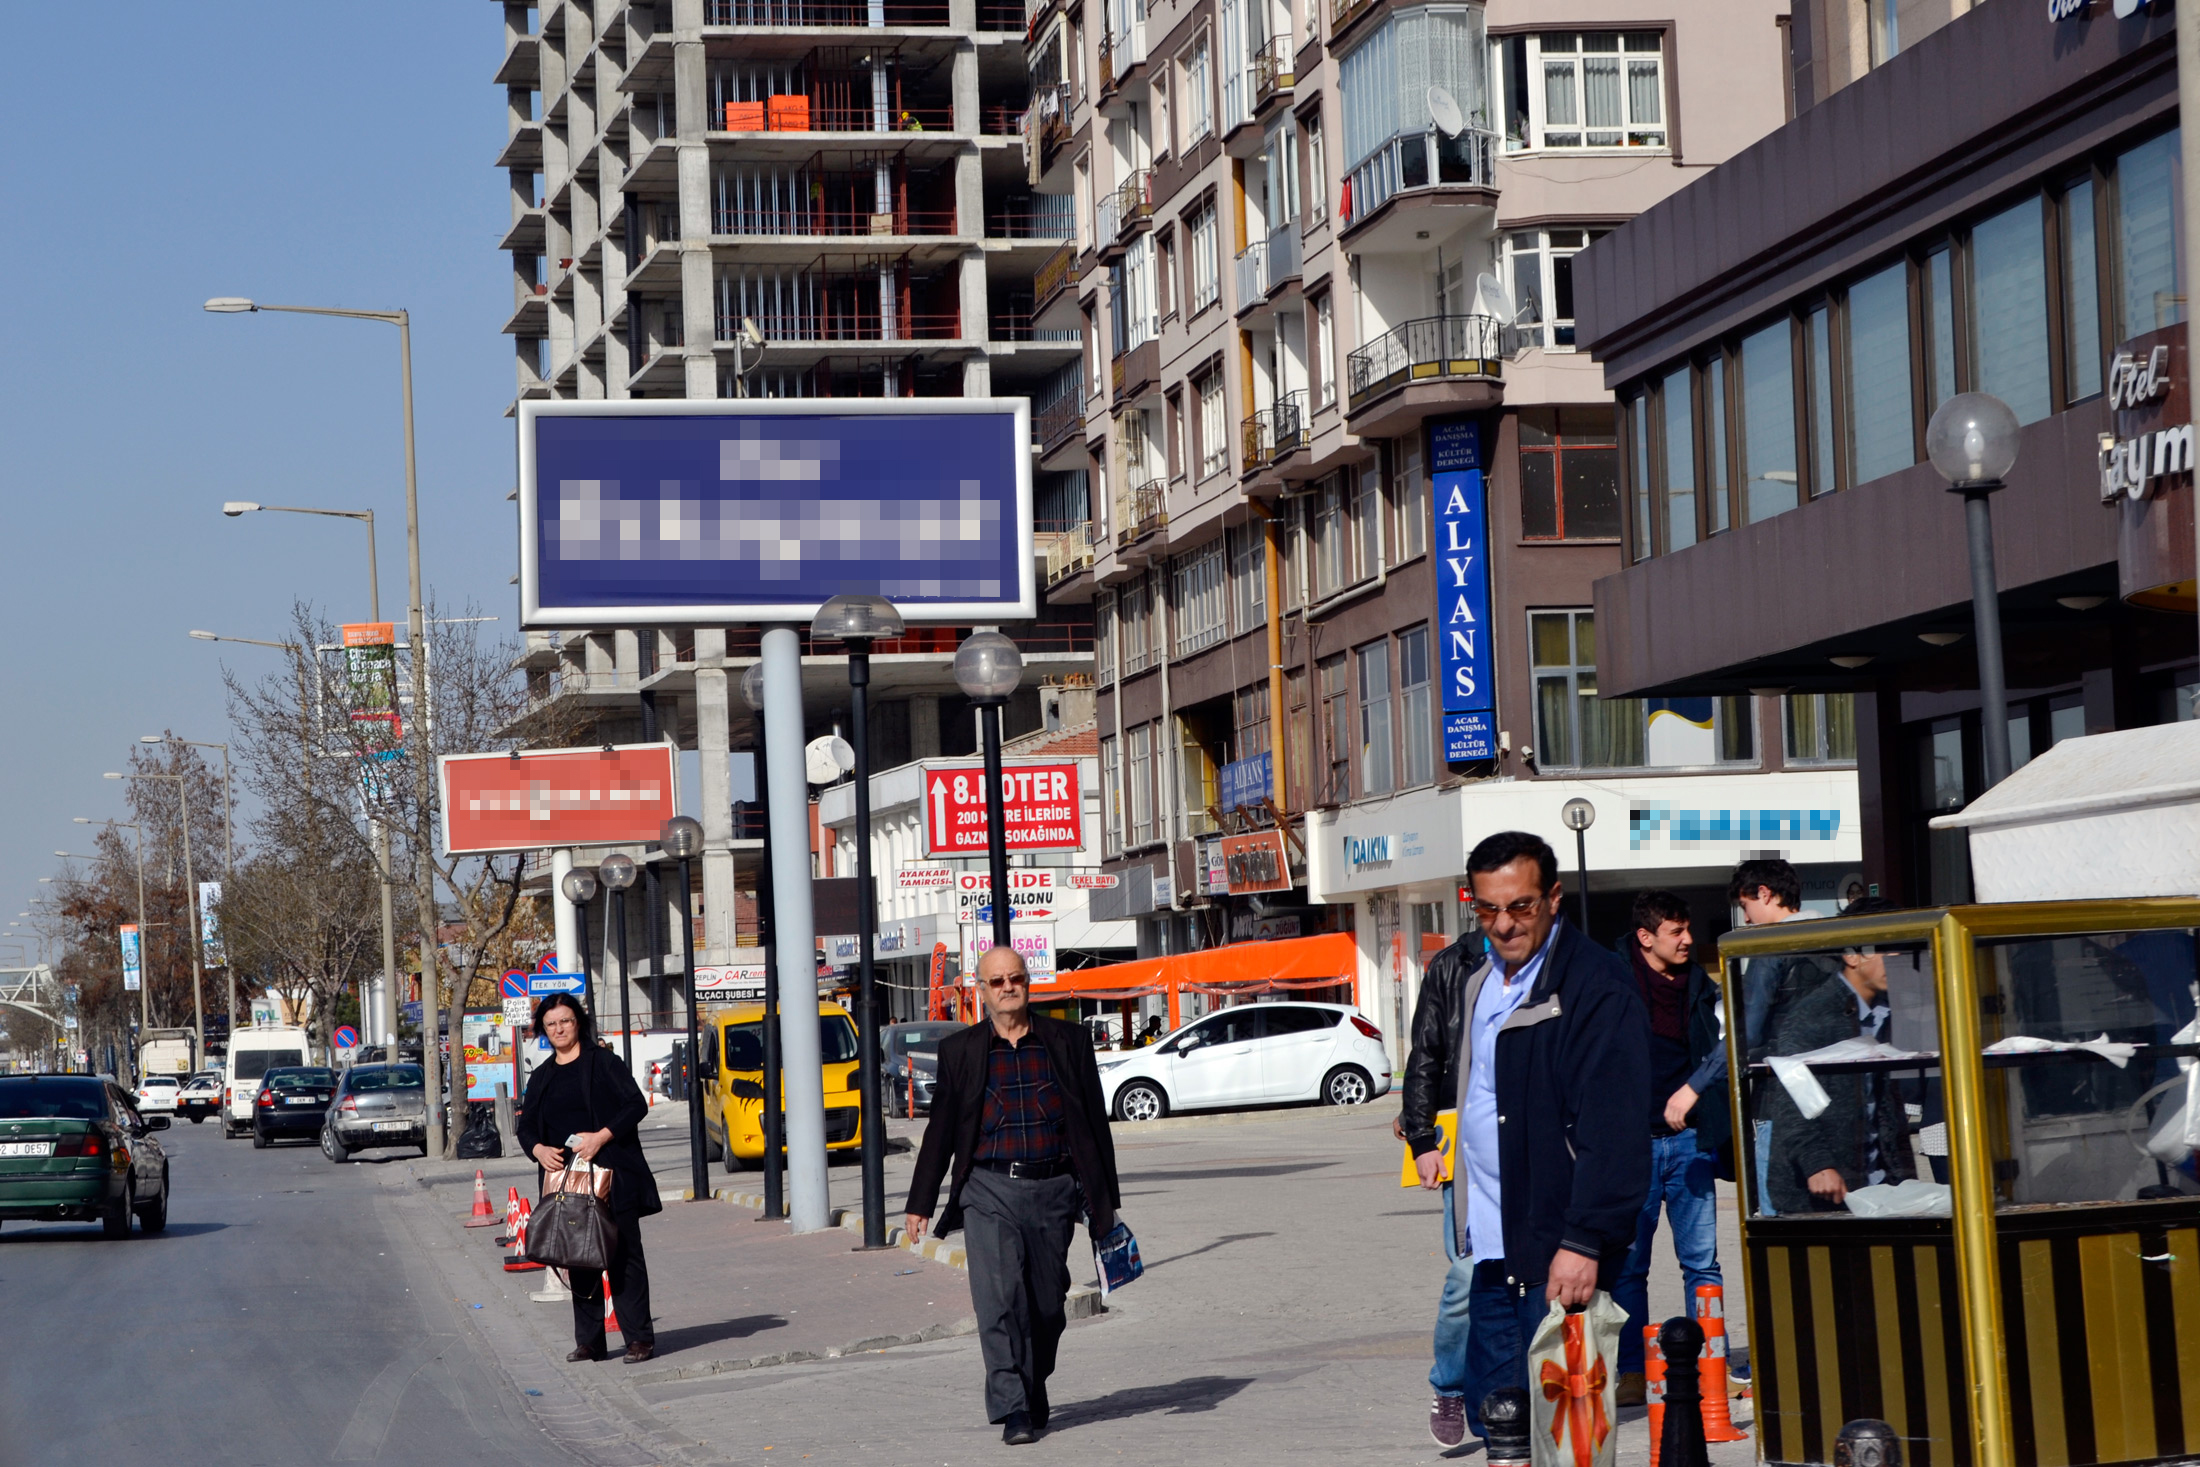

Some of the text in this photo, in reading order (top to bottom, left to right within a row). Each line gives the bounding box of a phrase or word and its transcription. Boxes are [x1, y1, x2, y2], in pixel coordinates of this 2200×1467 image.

[2109, 345, 2171, 411] Otel
[1443, 425, 1466, 433] ACAR
[1438, 448, 1472, 458] KÜLTÜR
[1444, 484, 1476, 698] ALYANS
[1455, 716, 1479, 725] ACAR
[1447, 724, 1487, 733] DANIŞMA
[1450, 740, 1486, 749] KÜLTÜR
[957, 804, 1072, 824] 200 MRE İLERİDE
[1005, 825, 1075, 843] SOKAĞINDA
[1353, 835, 1388, 865] DAIKIN
[899, 869, 950, 878] AYAKKABI
[1071, 876, 1093, 885] TEKEL
[1008, 892, 1053, 905] SALONU
[724, 970, 749, 980] CAR
[725, 989, 755, 1000] ŞUBESİ
[0, 1145, 7, 1155] 2
[13, 1145, 19, 1154] J
